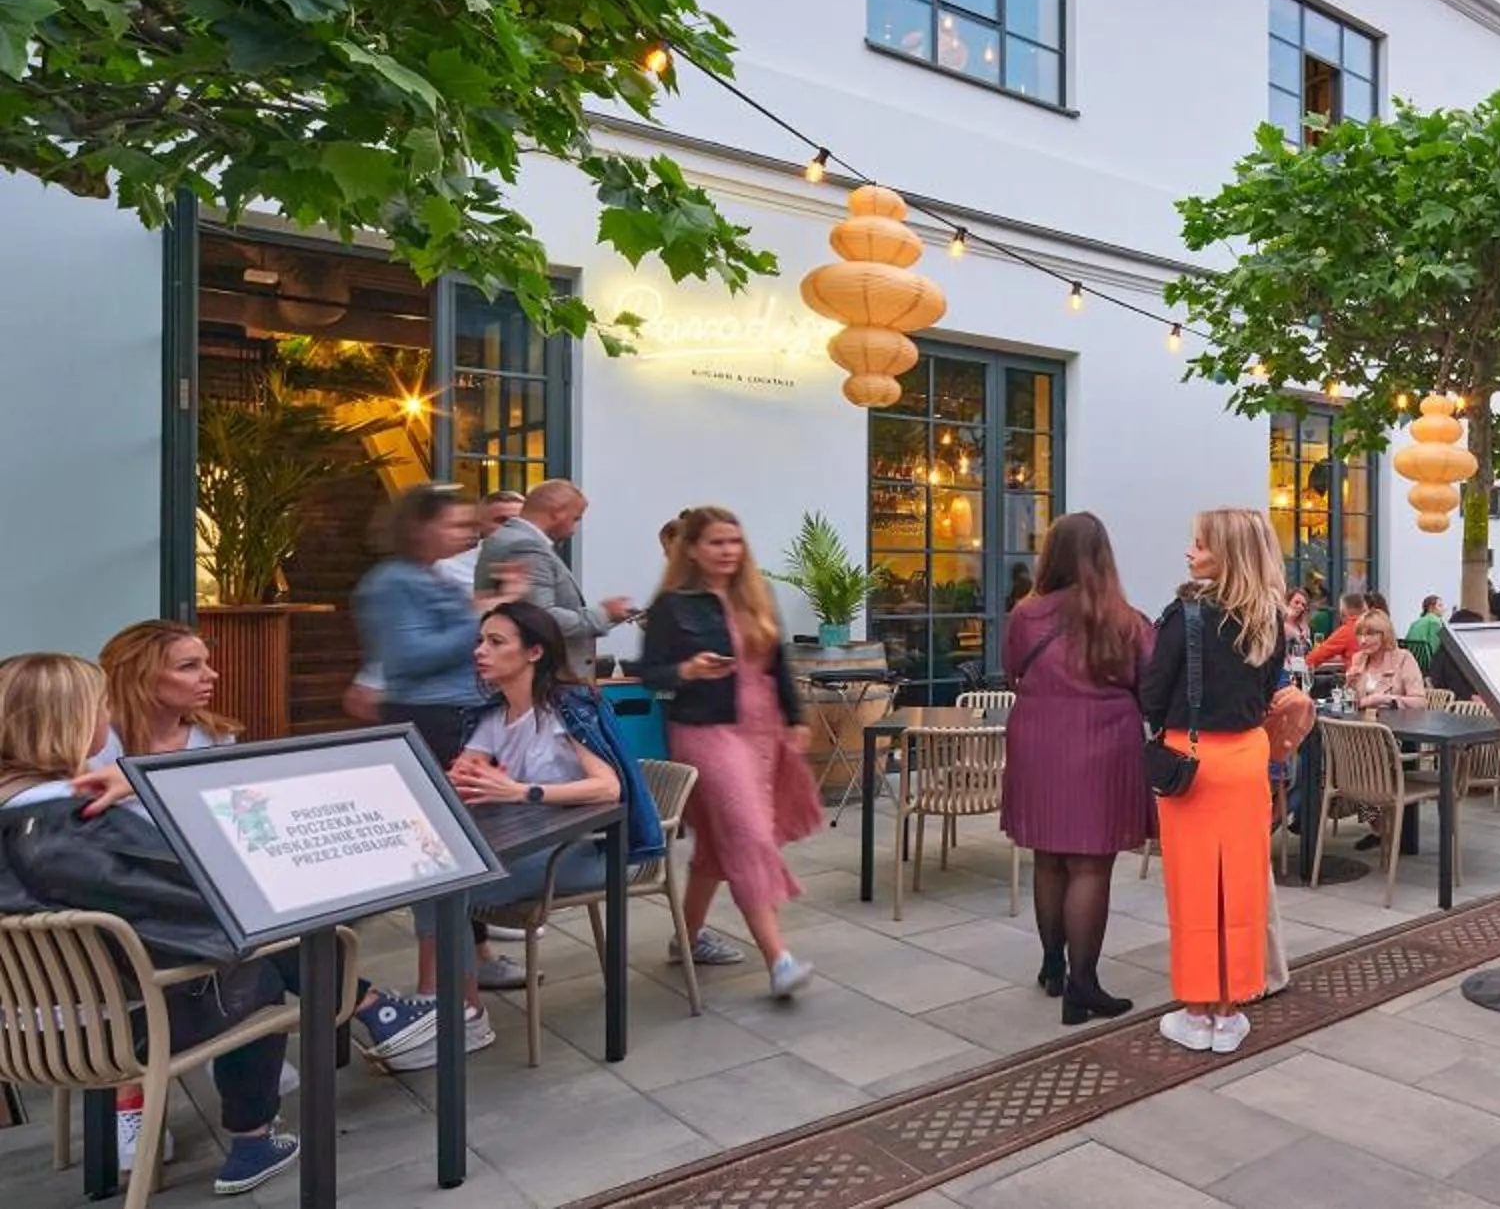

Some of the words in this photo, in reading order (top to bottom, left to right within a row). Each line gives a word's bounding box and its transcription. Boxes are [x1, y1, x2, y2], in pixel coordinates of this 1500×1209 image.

[289, 801, 356, 822] PROSIMY
[285, 815, 363, 838] POCZEKAJ
[365, 810, 385, 822] NA
[264, 830, 356, 858] WSKAZANIE
[355, 818, 412, 838] STOLIKA
[291, 847, 343, 867] PRZEZ
